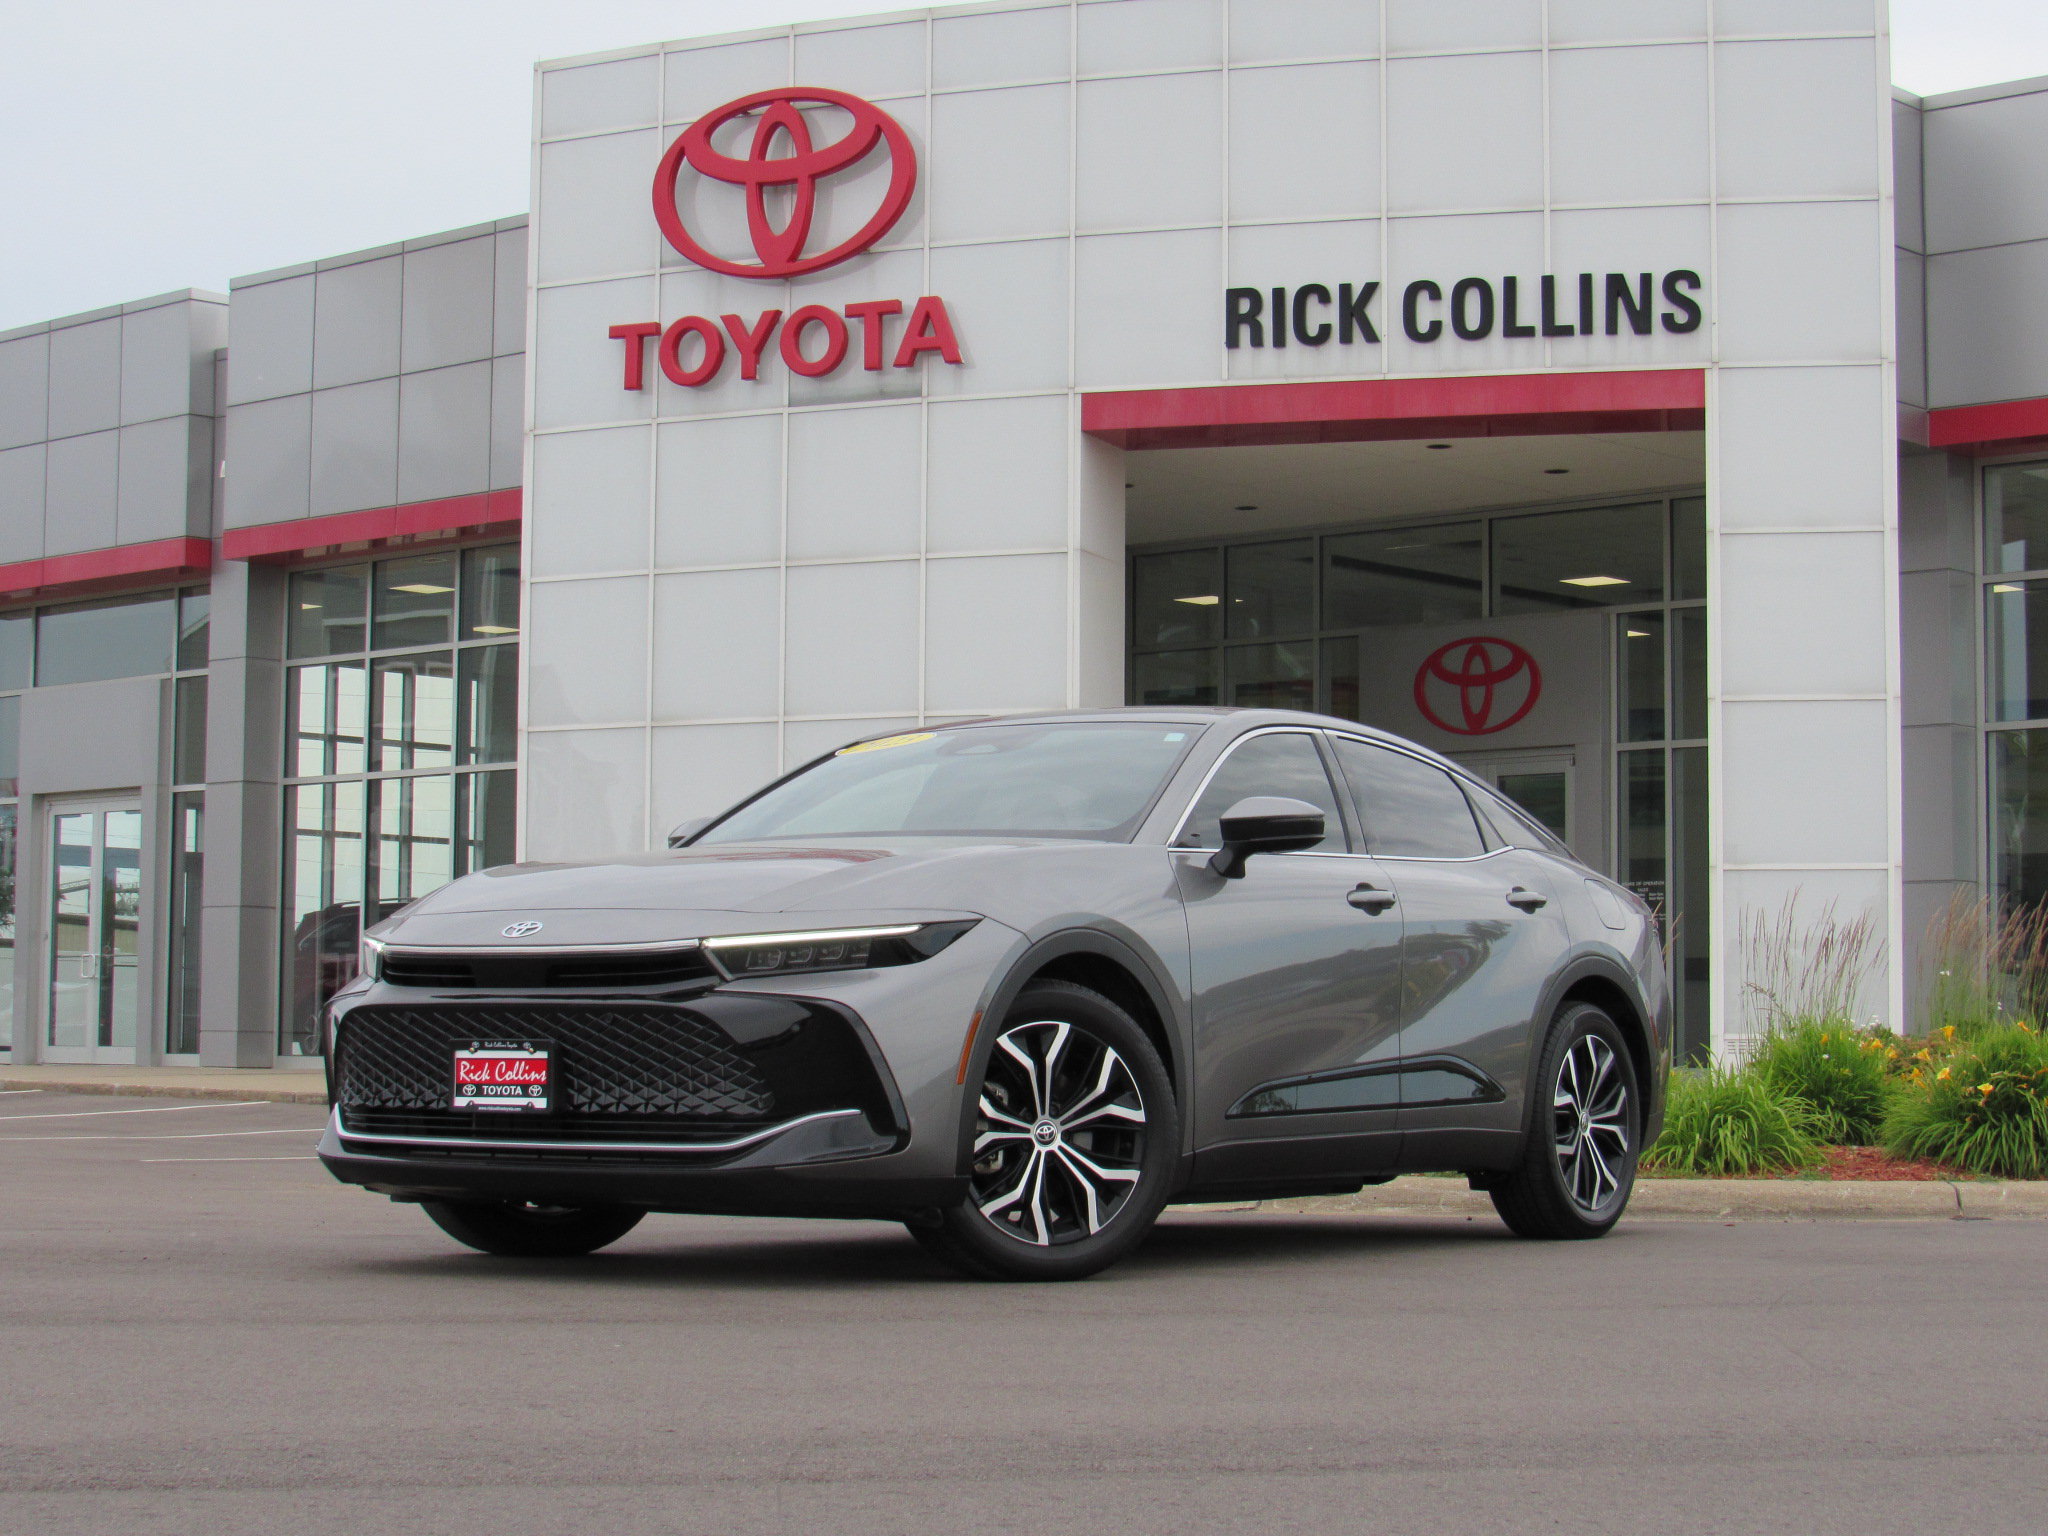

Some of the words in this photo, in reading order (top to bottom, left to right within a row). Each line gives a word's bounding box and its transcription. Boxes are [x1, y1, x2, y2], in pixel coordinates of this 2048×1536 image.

[1225, 282, 1381, 349] RICK
[1402, 270, 1702, 343] COLLINS
[609, 296, 963, 391] TOYOTA
[460, 1060, 491, 1081] Rick
[495, 1061, 547, 1082] Collins
[482, 1085, 522, 1095] TOYOTA
